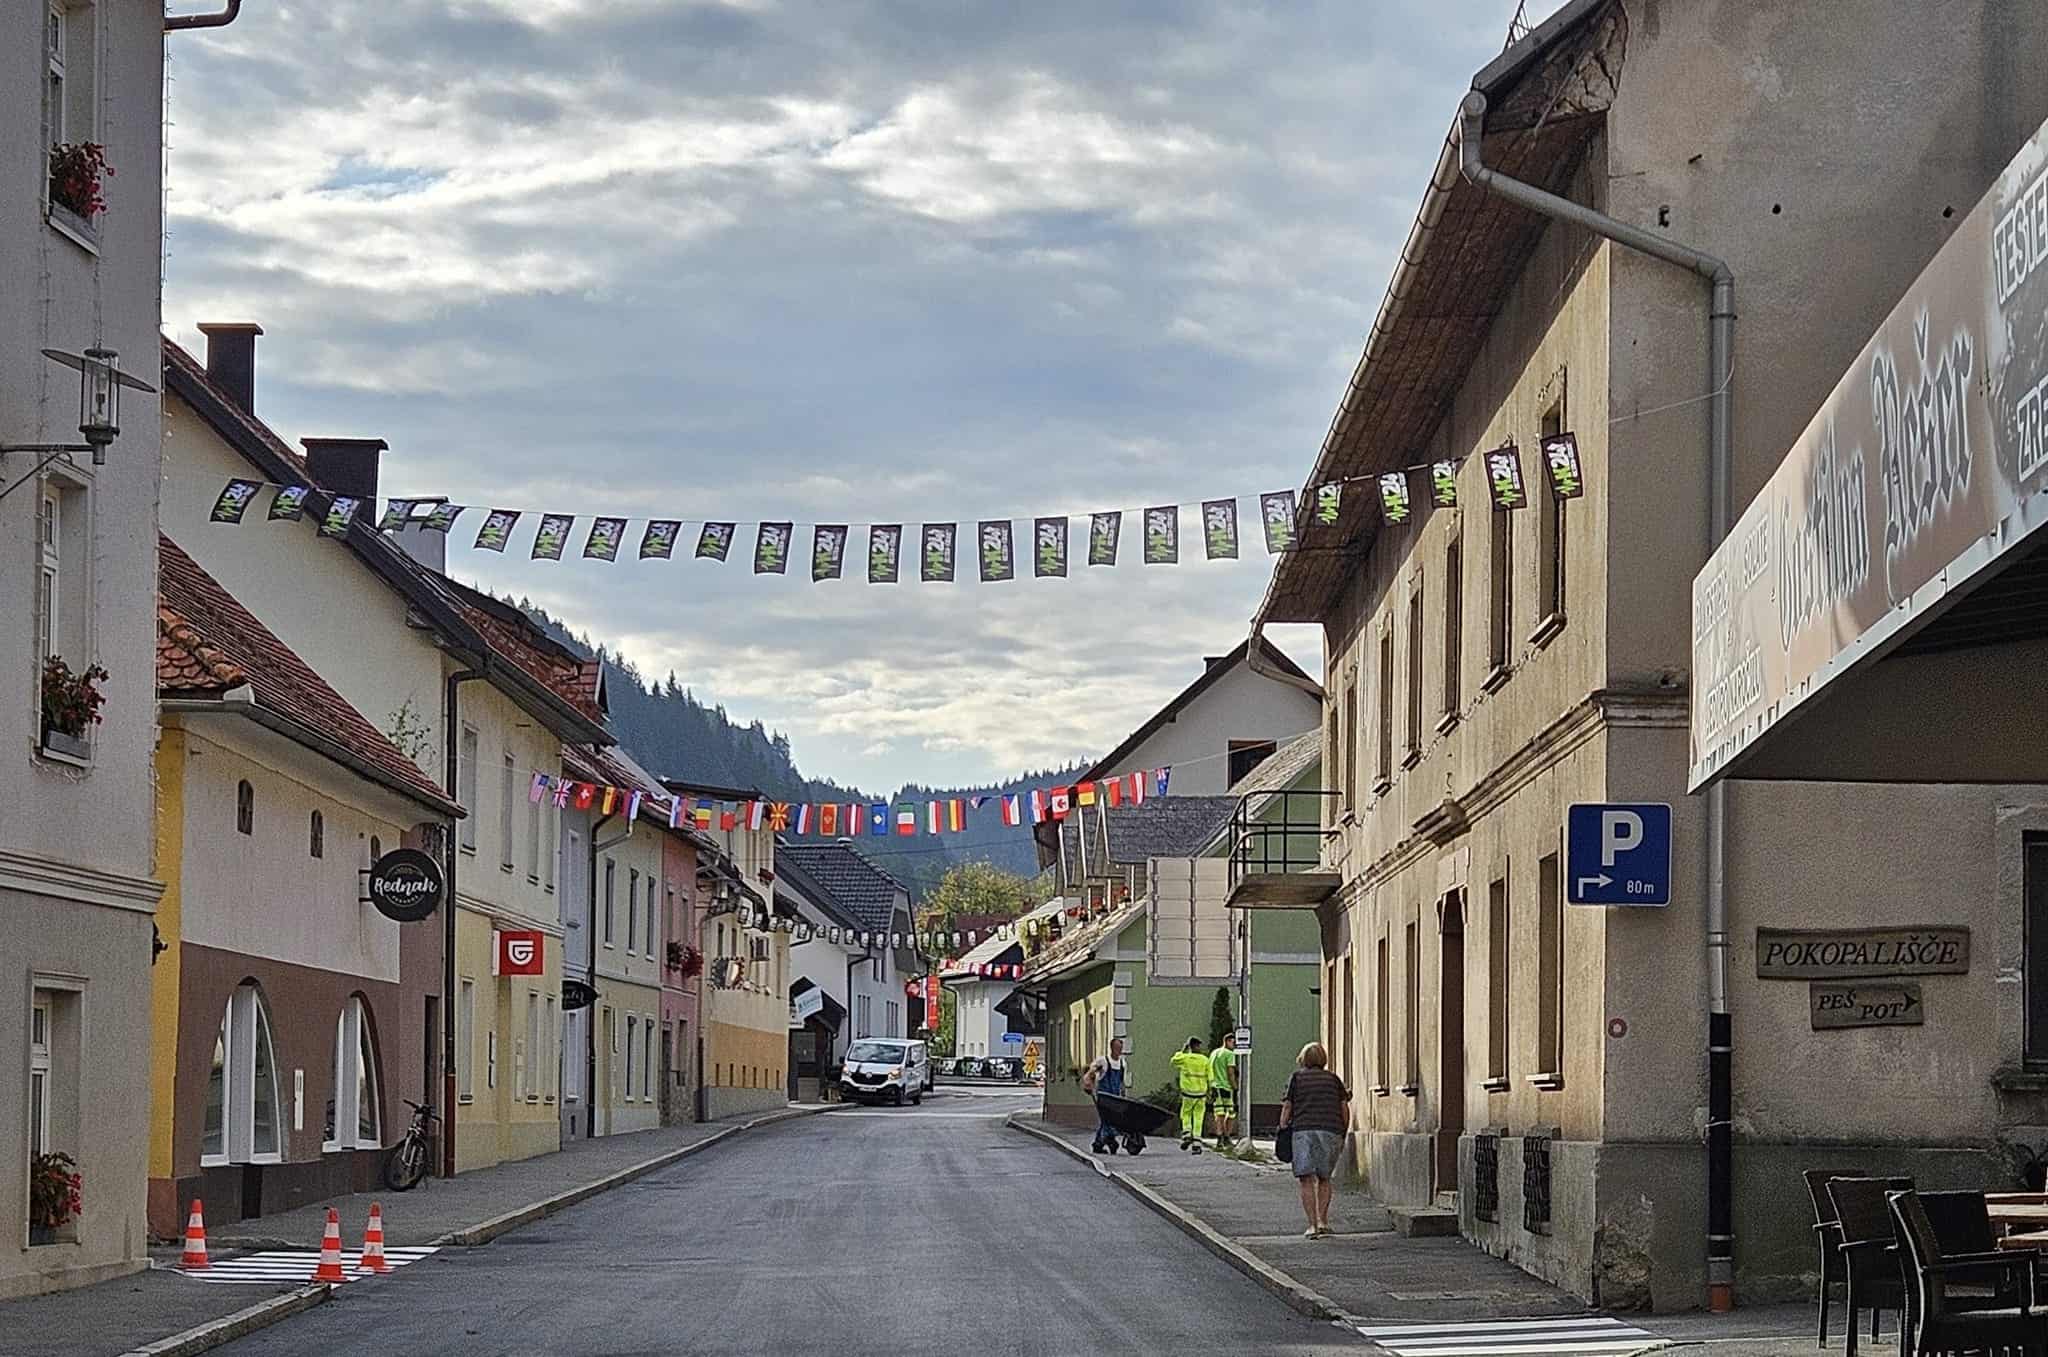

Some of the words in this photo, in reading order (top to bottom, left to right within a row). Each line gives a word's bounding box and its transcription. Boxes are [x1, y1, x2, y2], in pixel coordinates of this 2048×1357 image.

[1993, 166, 2048, 304] TESTE
[1602, 811, 1643, 866] P
[1763, 935, 1960, 966] POKOPALIŠČE
[1817, 989, 1857, 1011] PEŠ
[1861, 1003, 1905, 1021] POT
